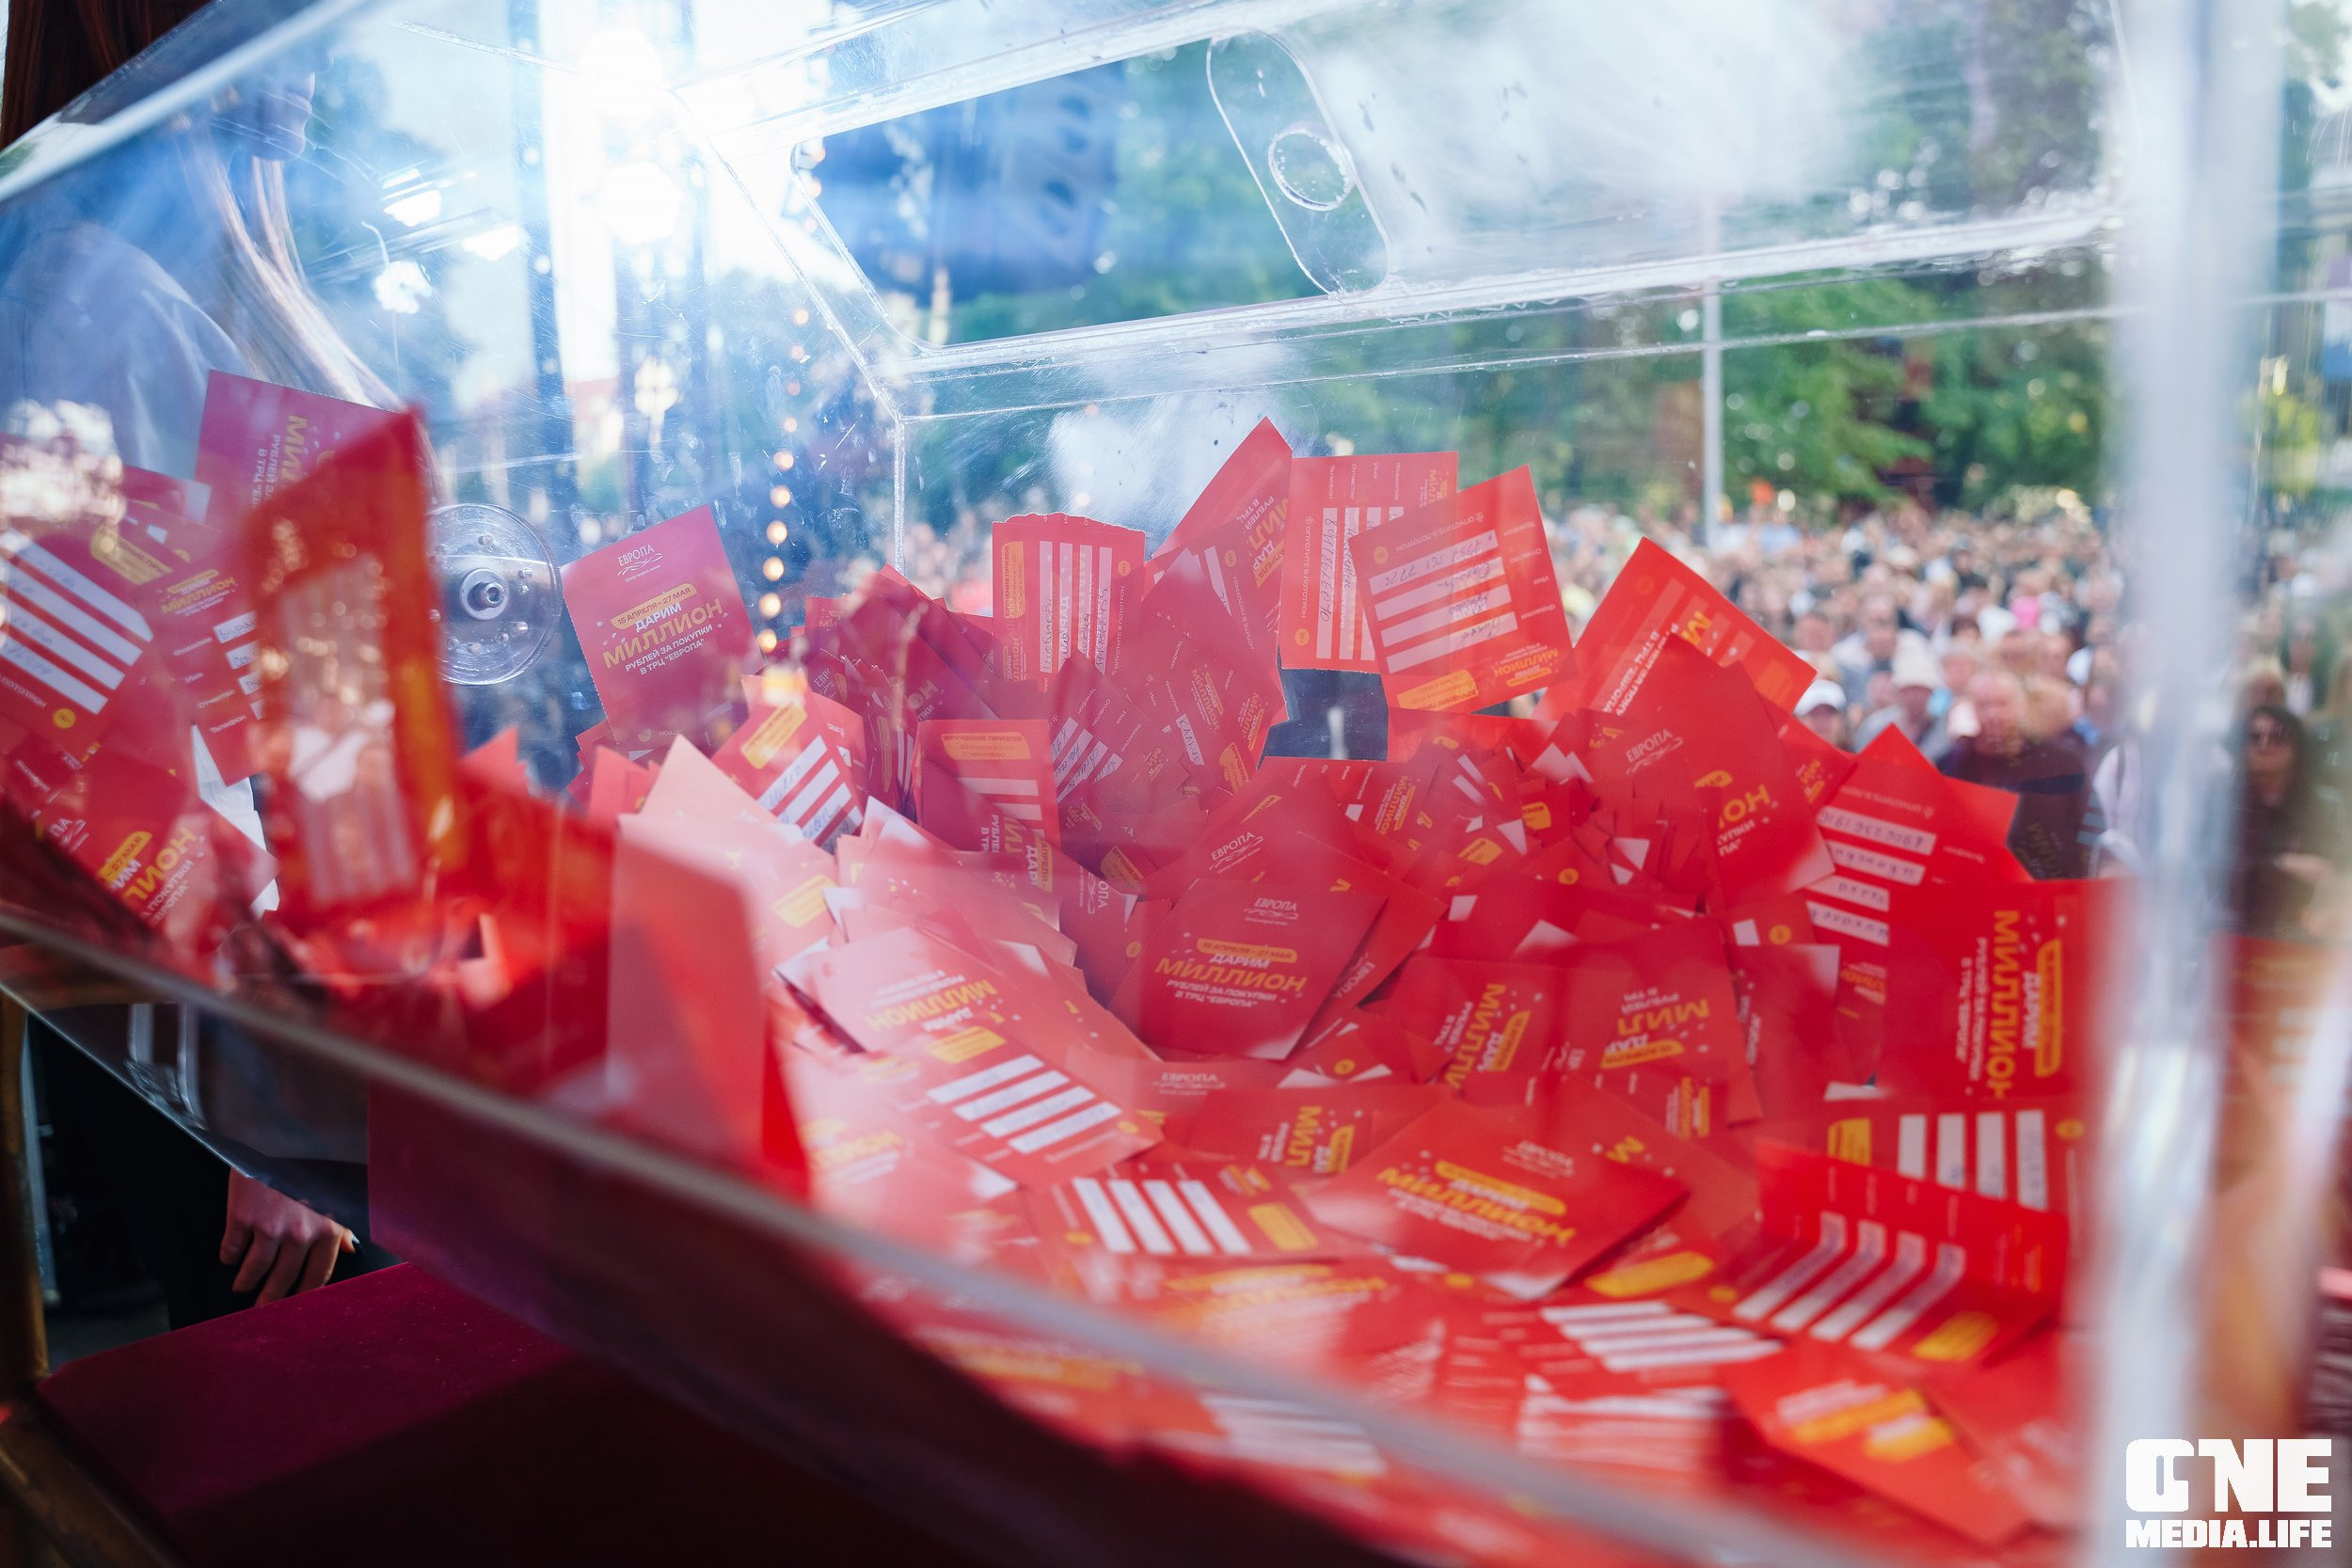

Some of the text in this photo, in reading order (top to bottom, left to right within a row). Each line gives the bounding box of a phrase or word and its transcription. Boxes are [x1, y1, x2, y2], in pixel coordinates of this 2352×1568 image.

[617, 545, 655, 566] ЕВРОПА
[1302, 525, 1311, 567] ОПУСТИТЕ
[162, 578, 234, 612] МИЛЛИОН
[627, 602, 658, 621] АПРЕЛЯ
[662, 594, 672, 604] 27
[672, 587, 691, 599] МАЯ
[632, 601, 681, 632] ДАРИМ
[603, 599, 723, 667] МИЛЛИОН
[625, 624, 713, 672] РУБЛЕЙ ЗА ПОКУПКИ
[640, 638, 704, 675] В ТРЦ "ЕВРОПА"
[1492, 649, 1558, 676] МИЛЛИОН
[1192, 669, 1219, 729] МИЛЛИОН
[1626, 730, 1672, 762] ЕВРОПА
[1724, 784, 1773, 821] ОН
[1211, 832, 1255, 860] ЕВРОПА
[1097, 880, 1109, 909] ОПА
[1255, 897, 1296, 911] ЕВРОПА
[1209, 949, 1271, 969] ДАРИМ
[1157, 958, 1306, 995] МИЛЛИОН
[1167, 979, 1209, 991] РУБЛЕЙ
[1185, 991, 1205, 1002] ТРЦ
